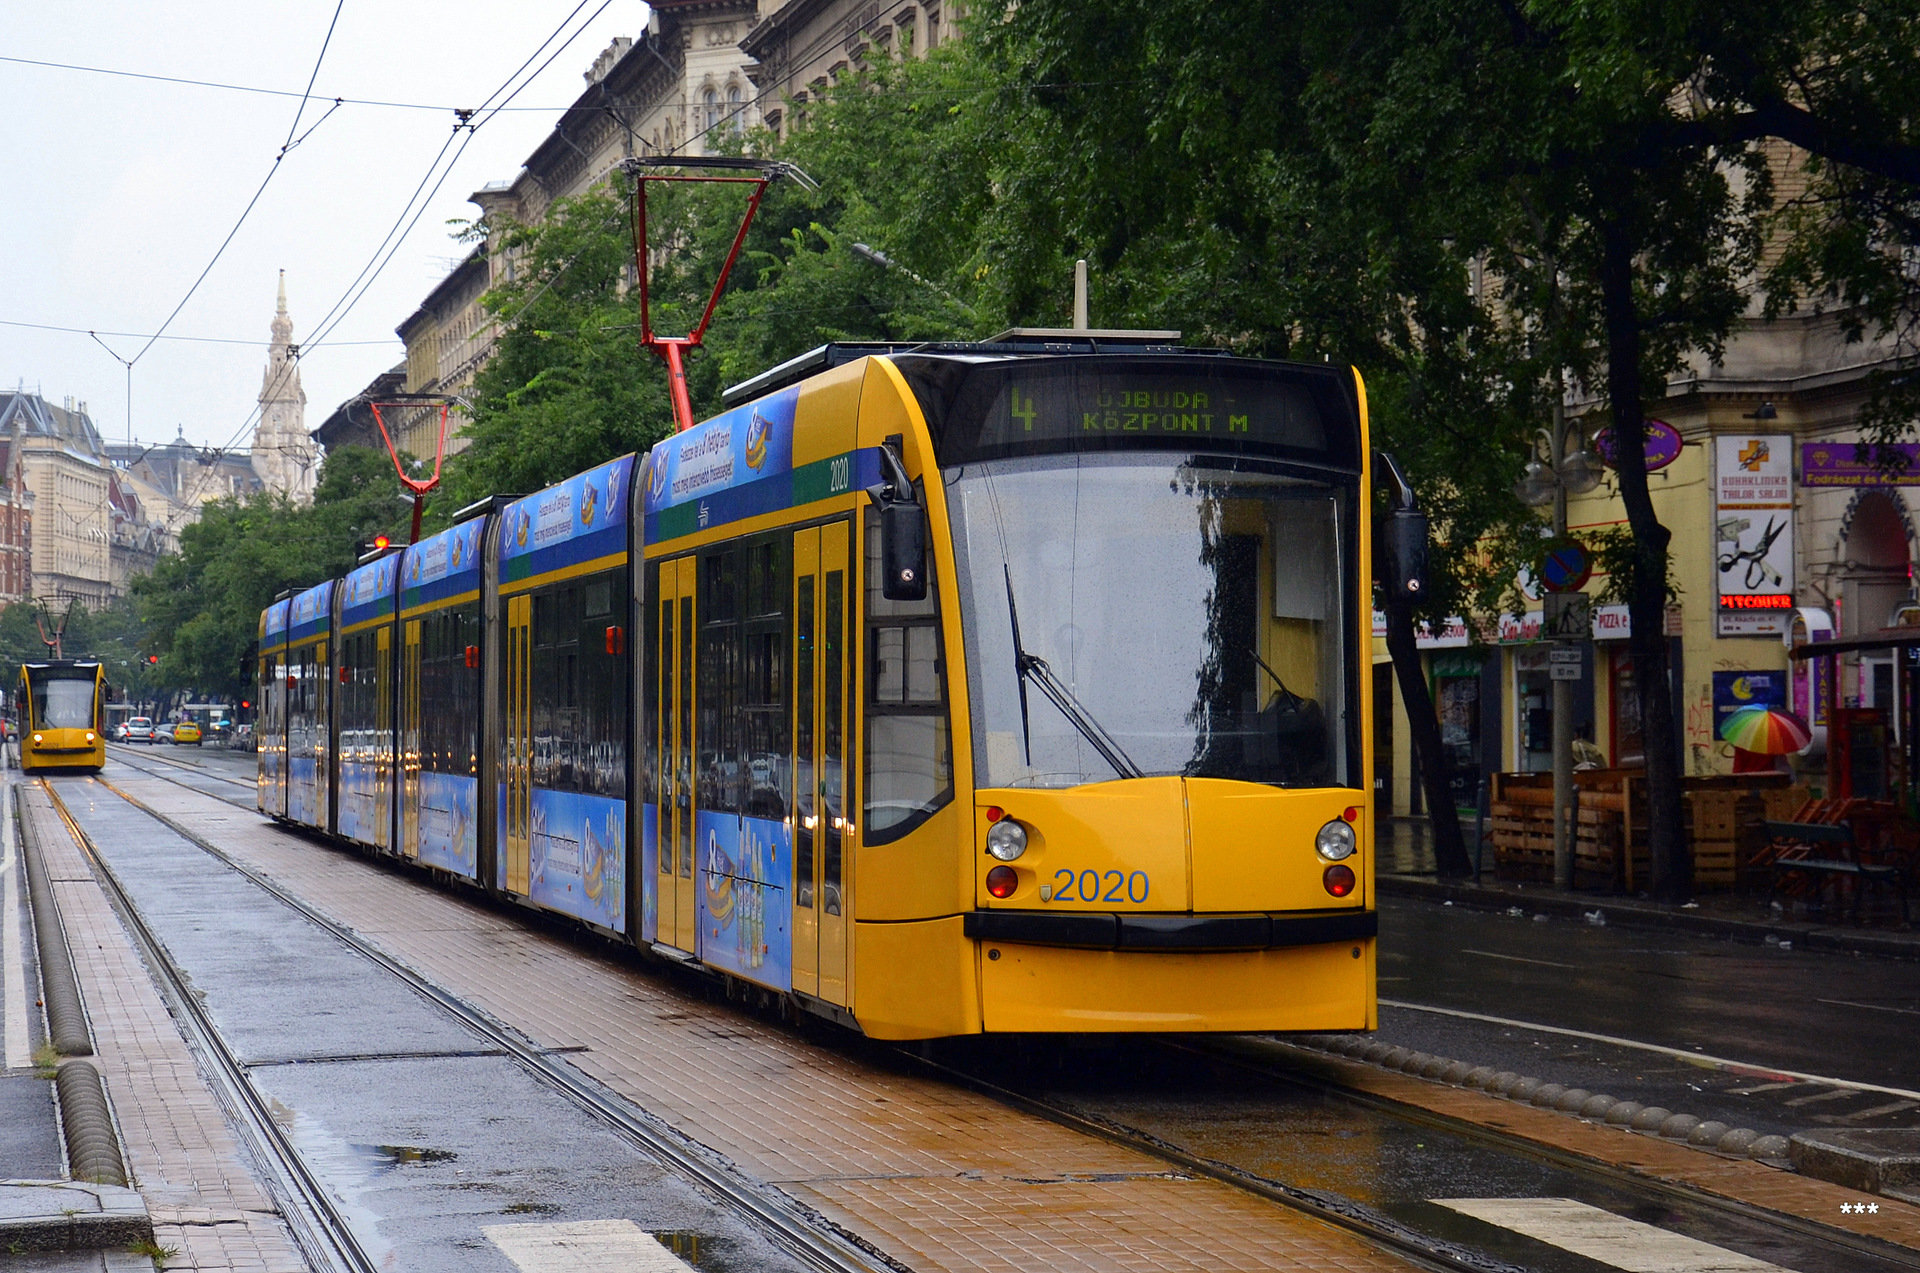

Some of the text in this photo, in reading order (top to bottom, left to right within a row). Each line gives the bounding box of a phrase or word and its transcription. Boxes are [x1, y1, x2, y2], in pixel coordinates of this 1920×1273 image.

[1011, 385, 1037, 433] 4
[1229, 413, 1248, 432] M
[830, 456, 848, 493] 2020
[1723, 489, 1787, 499] TAILOR SALON
[1599, 613, 1620, 629] PIZZA
[1053, 868, 1150, 903] 2020
